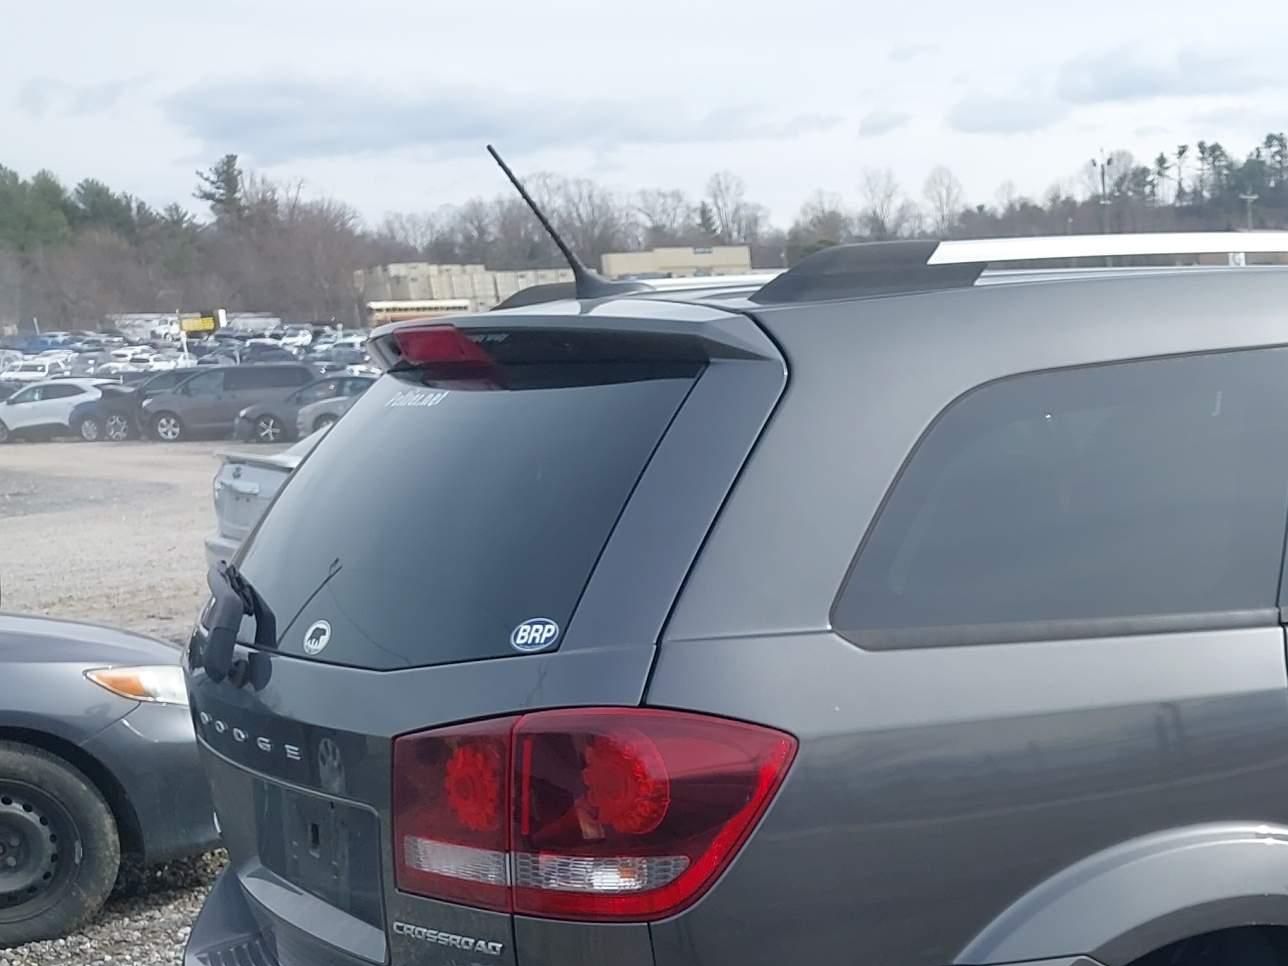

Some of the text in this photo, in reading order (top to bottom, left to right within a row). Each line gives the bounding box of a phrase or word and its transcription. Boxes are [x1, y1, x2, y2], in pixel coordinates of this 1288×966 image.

[516, 624, 555, 644] BRP
[200, 711, 302, 760] DODGE
[392, 921, 503, 955] CROSSROAD
